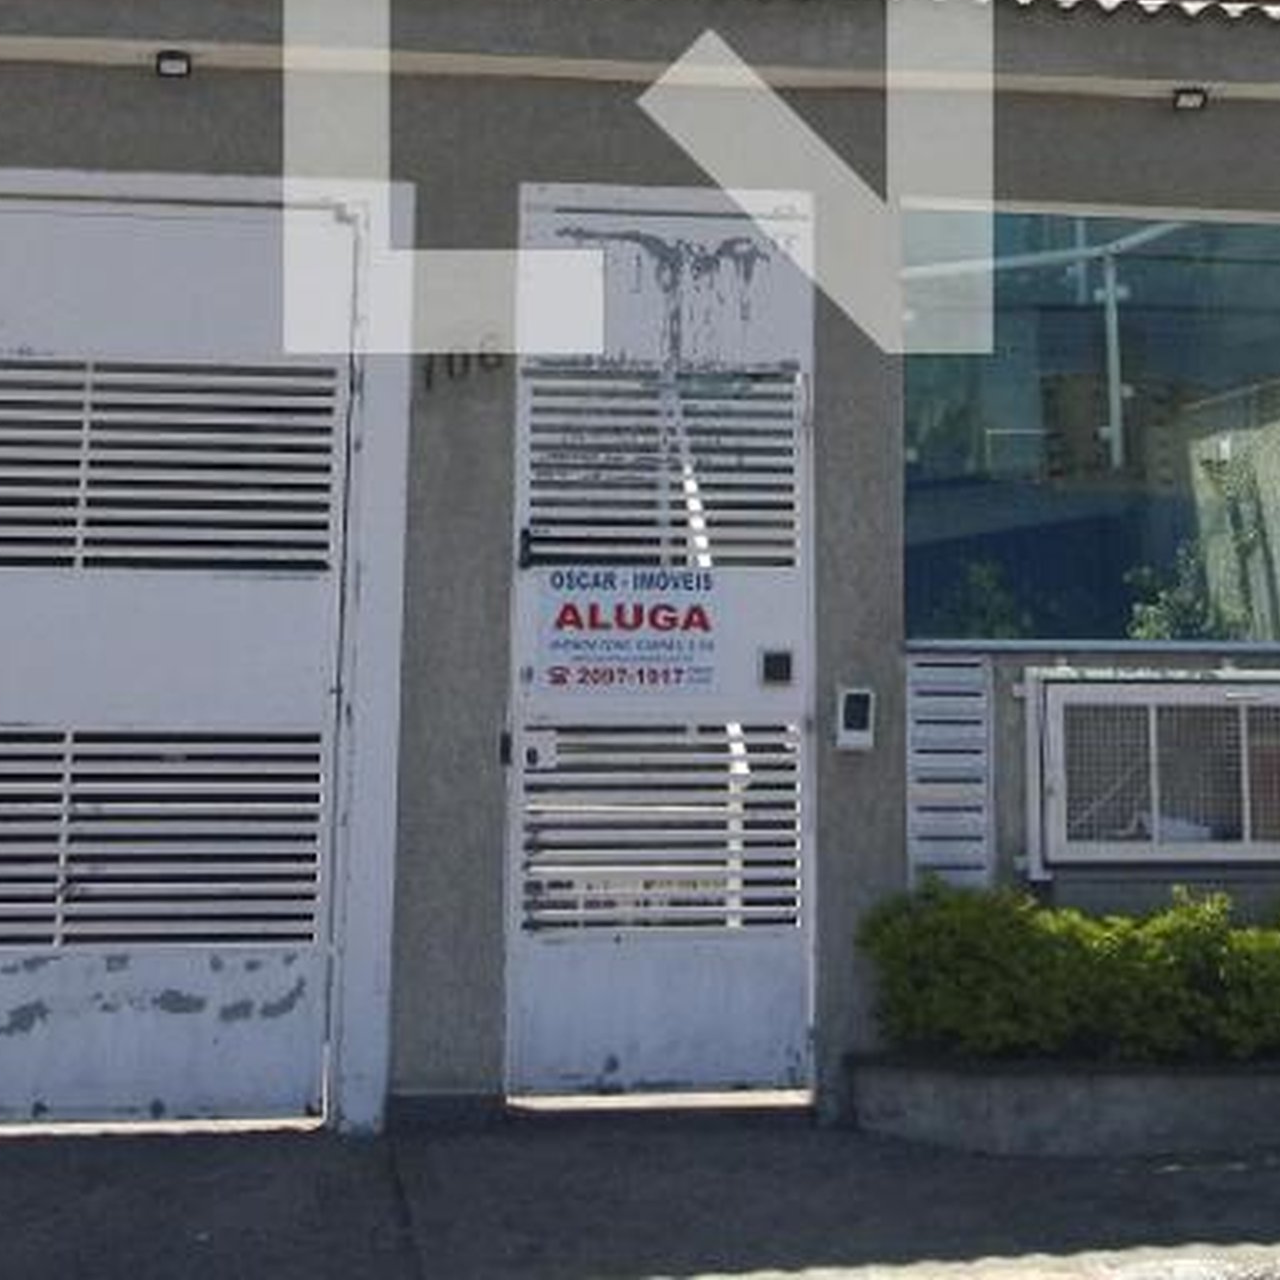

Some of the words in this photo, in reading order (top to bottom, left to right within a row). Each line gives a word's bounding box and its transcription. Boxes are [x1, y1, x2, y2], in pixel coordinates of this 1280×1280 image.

[550, 571, 617, 591] OSCAR
[633, 571, 713, 591] IMÓVEIS
[555, 602, 711, 632] ALUGA
